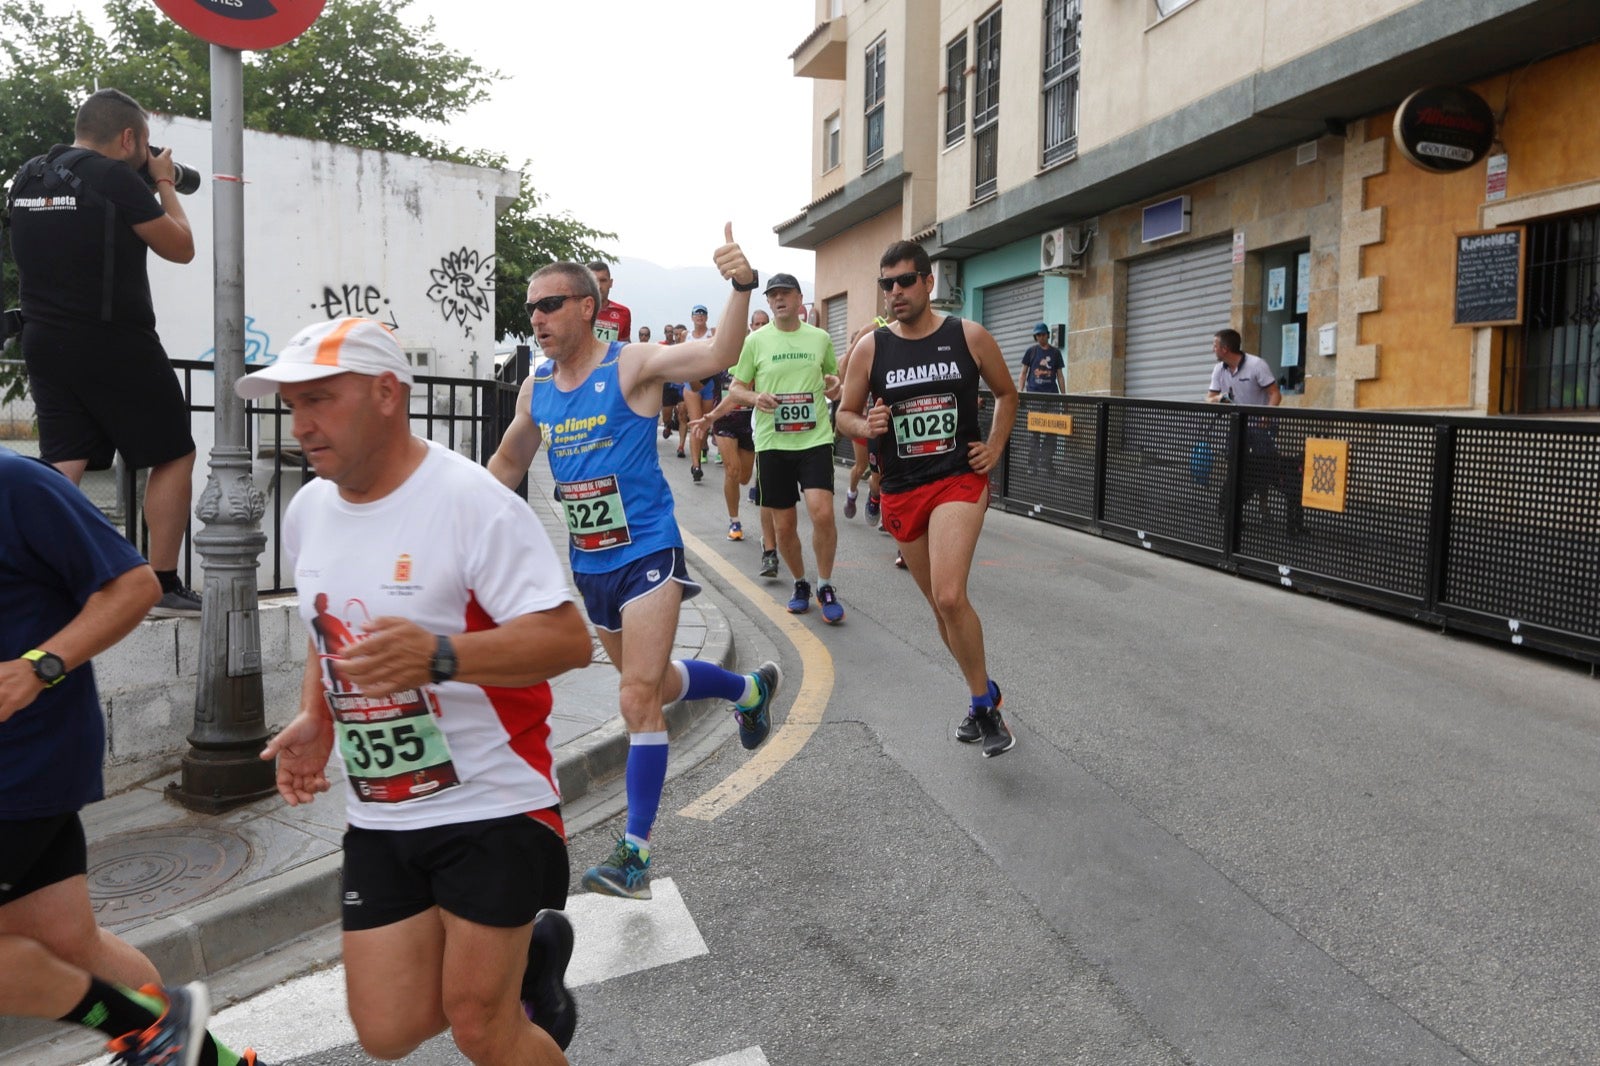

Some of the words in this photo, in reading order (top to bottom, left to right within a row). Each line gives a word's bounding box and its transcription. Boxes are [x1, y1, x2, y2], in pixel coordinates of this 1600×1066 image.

[772, 353, 808, 361] MARCELINO
[886, 361, 961, 385] GRANADA
[555, 414, 607, 434] olimpo
[780, 405, 810, 420] 690
[899, 412, 956, 439] 1028
[567, 500, 613, 529] 522
[347, 724, 425, 770] 355
